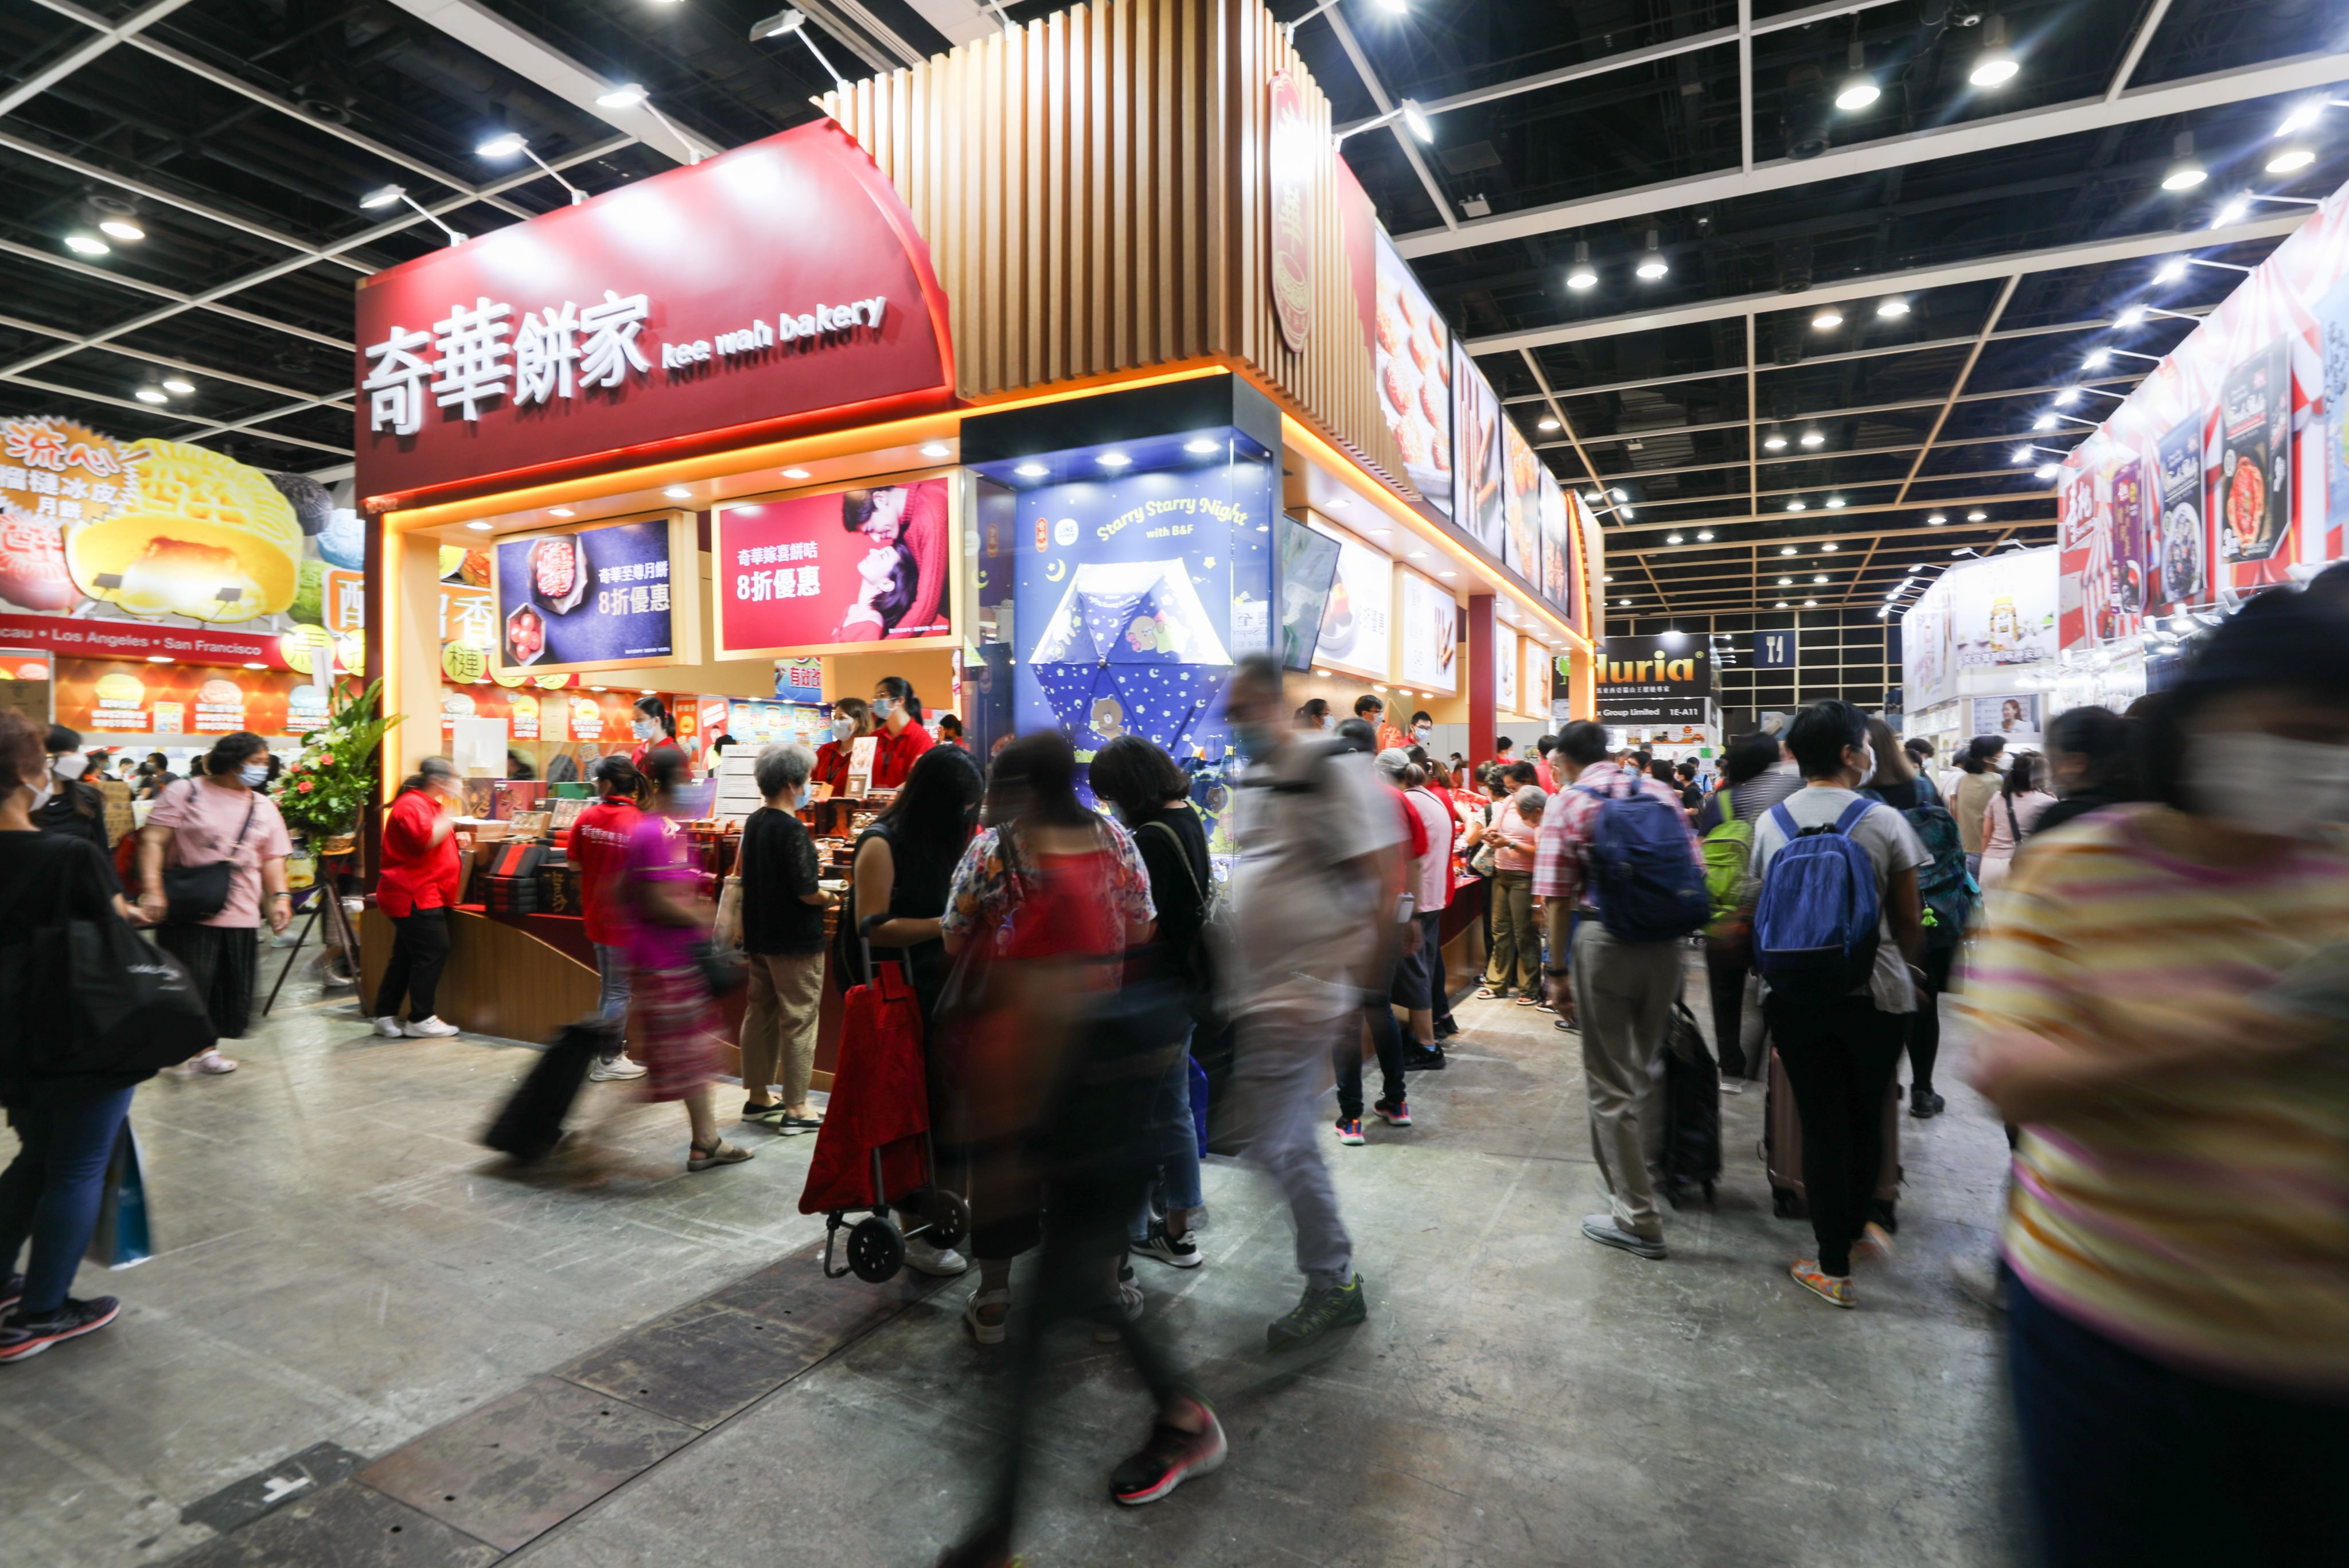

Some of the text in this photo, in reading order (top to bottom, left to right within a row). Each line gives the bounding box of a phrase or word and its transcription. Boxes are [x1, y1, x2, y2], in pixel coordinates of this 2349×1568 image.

[662, 296, 887, 370] kee wah bakery
[362, 289, 651, 436] 奇華餅家
[1097, 497, 1248, 541] Starry Starry Night
[1147, 524, 1194, 538] with B&F
[598, 583, 670, 616] 8折優惠
[737, 565, 820, 602] 8折優惠
[52, 629, 82, 643] Los
[86, 631, 149, 649] Angeles
[163, 637, 192, 651] San
[195, 639, 262, 656] Francisco
[1603, 709, 1629, 717] Group
[1630, 708, 1661, 716] Limited
